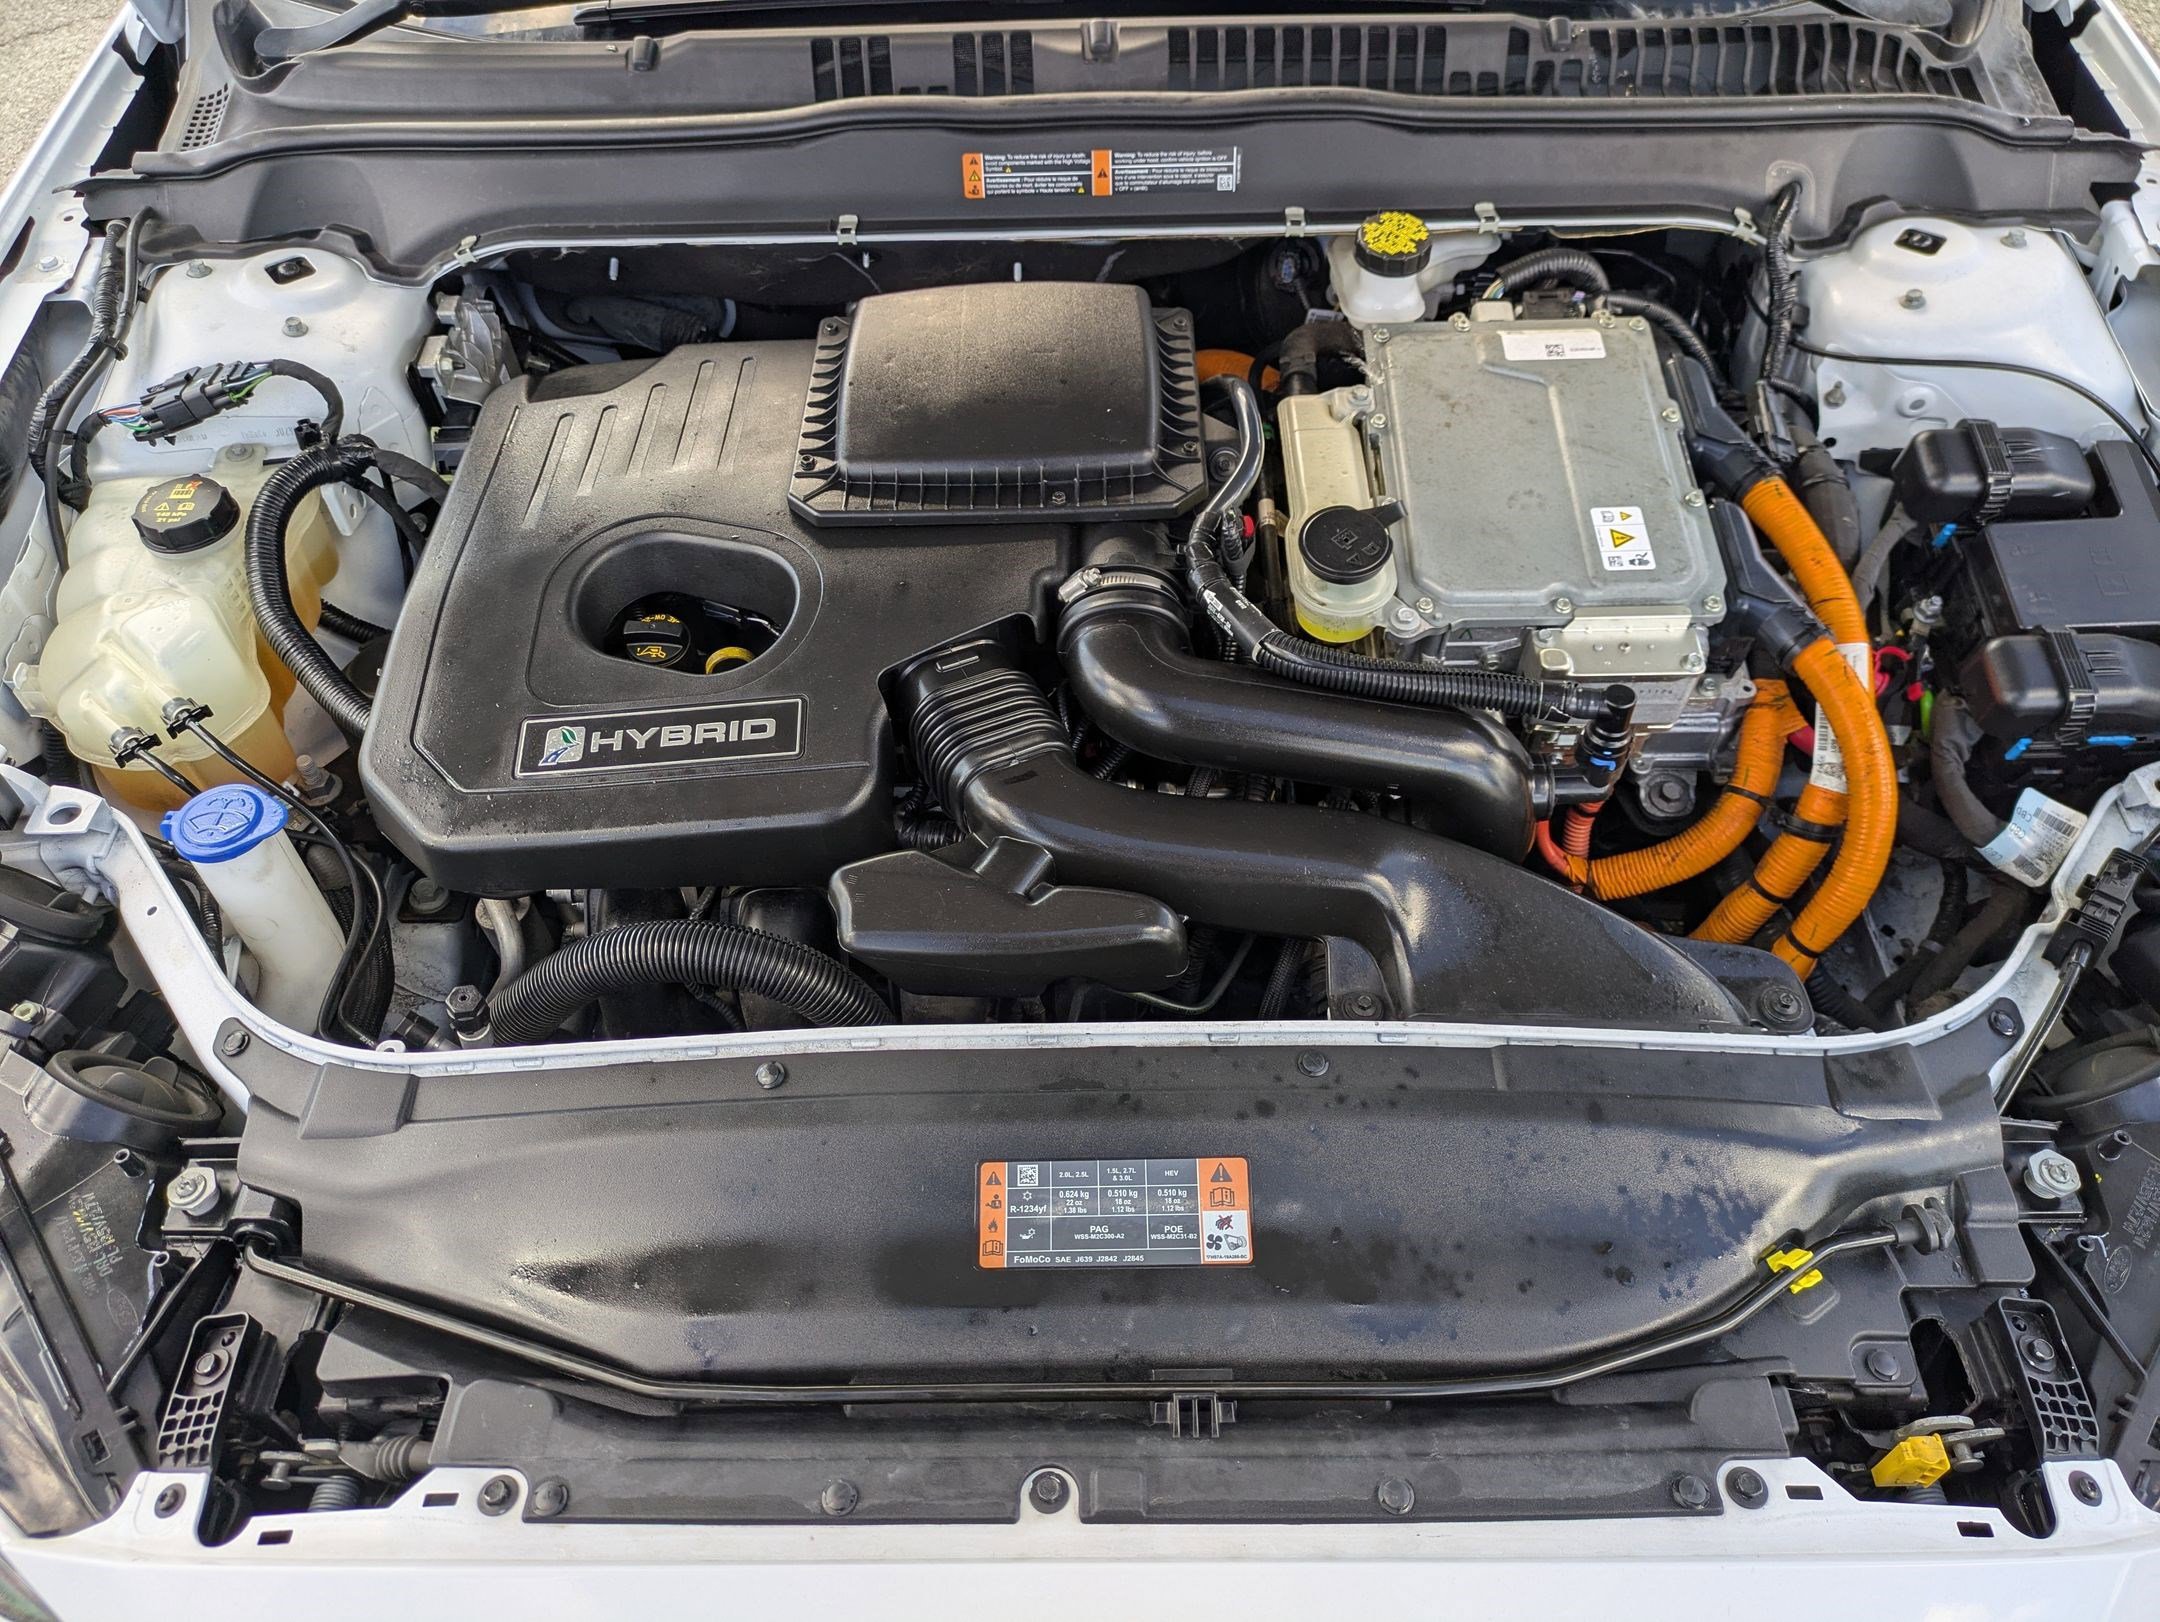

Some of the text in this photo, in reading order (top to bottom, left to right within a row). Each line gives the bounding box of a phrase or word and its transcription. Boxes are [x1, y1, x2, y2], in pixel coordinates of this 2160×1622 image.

[590, 718, 776, 752] HYBRID
[1080, 1190, 1089, 1199] kg
[1128, 1190, 1138, 1198] kg
[1178, 1188, 1187, 1198] kg
[1010, 1204, 1047, 1214] R-1234yf
[1014, 1256, 1051, 1264] FoMoCo
